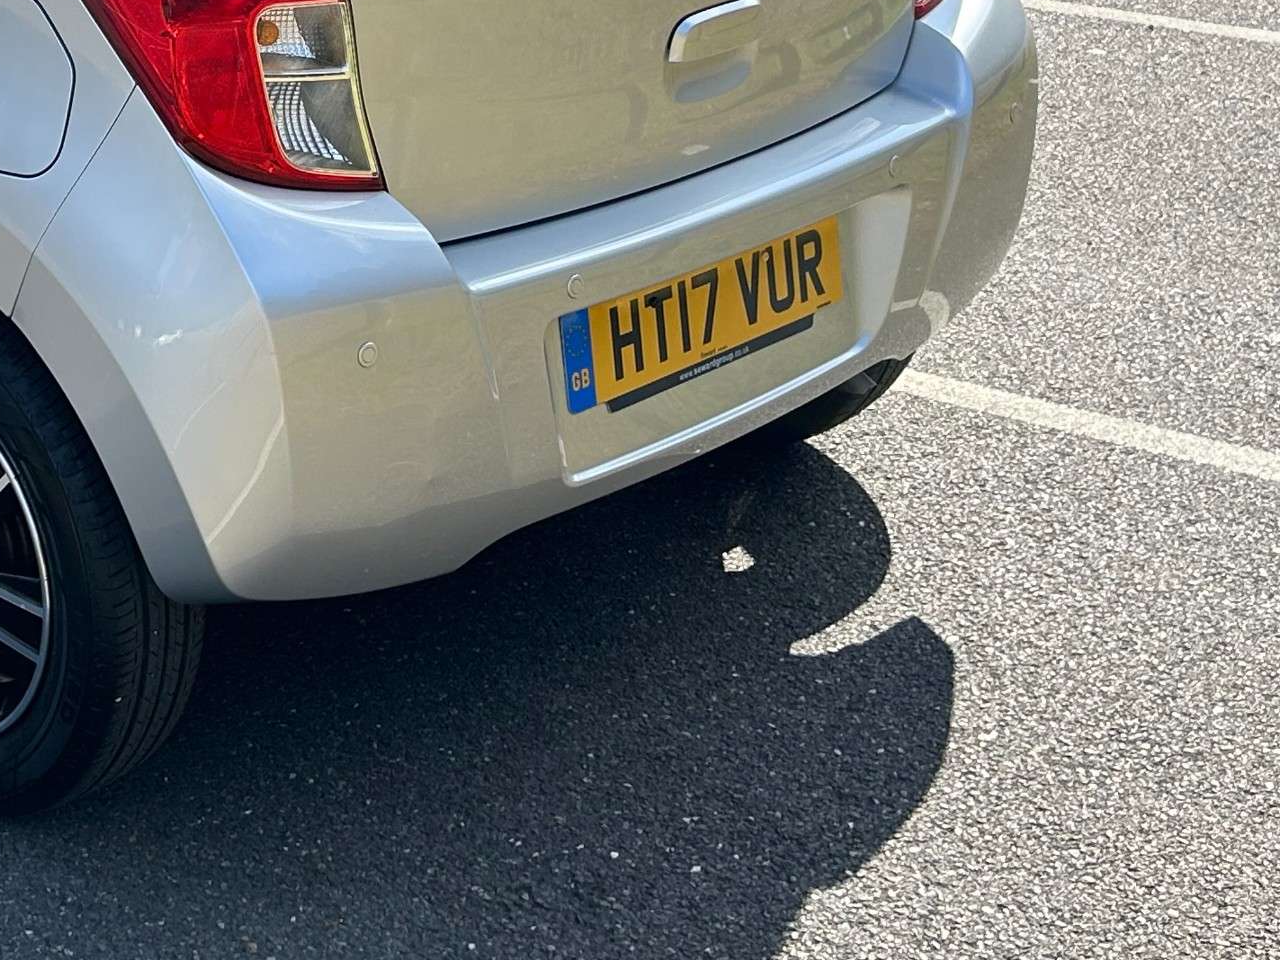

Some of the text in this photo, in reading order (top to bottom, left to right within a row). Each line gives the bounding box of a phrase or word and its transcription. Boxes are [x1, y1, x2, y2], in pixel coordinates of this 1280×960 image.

[609, 229, 825, 382] HT17 VUR
[572, 367, 590, 391] GB
